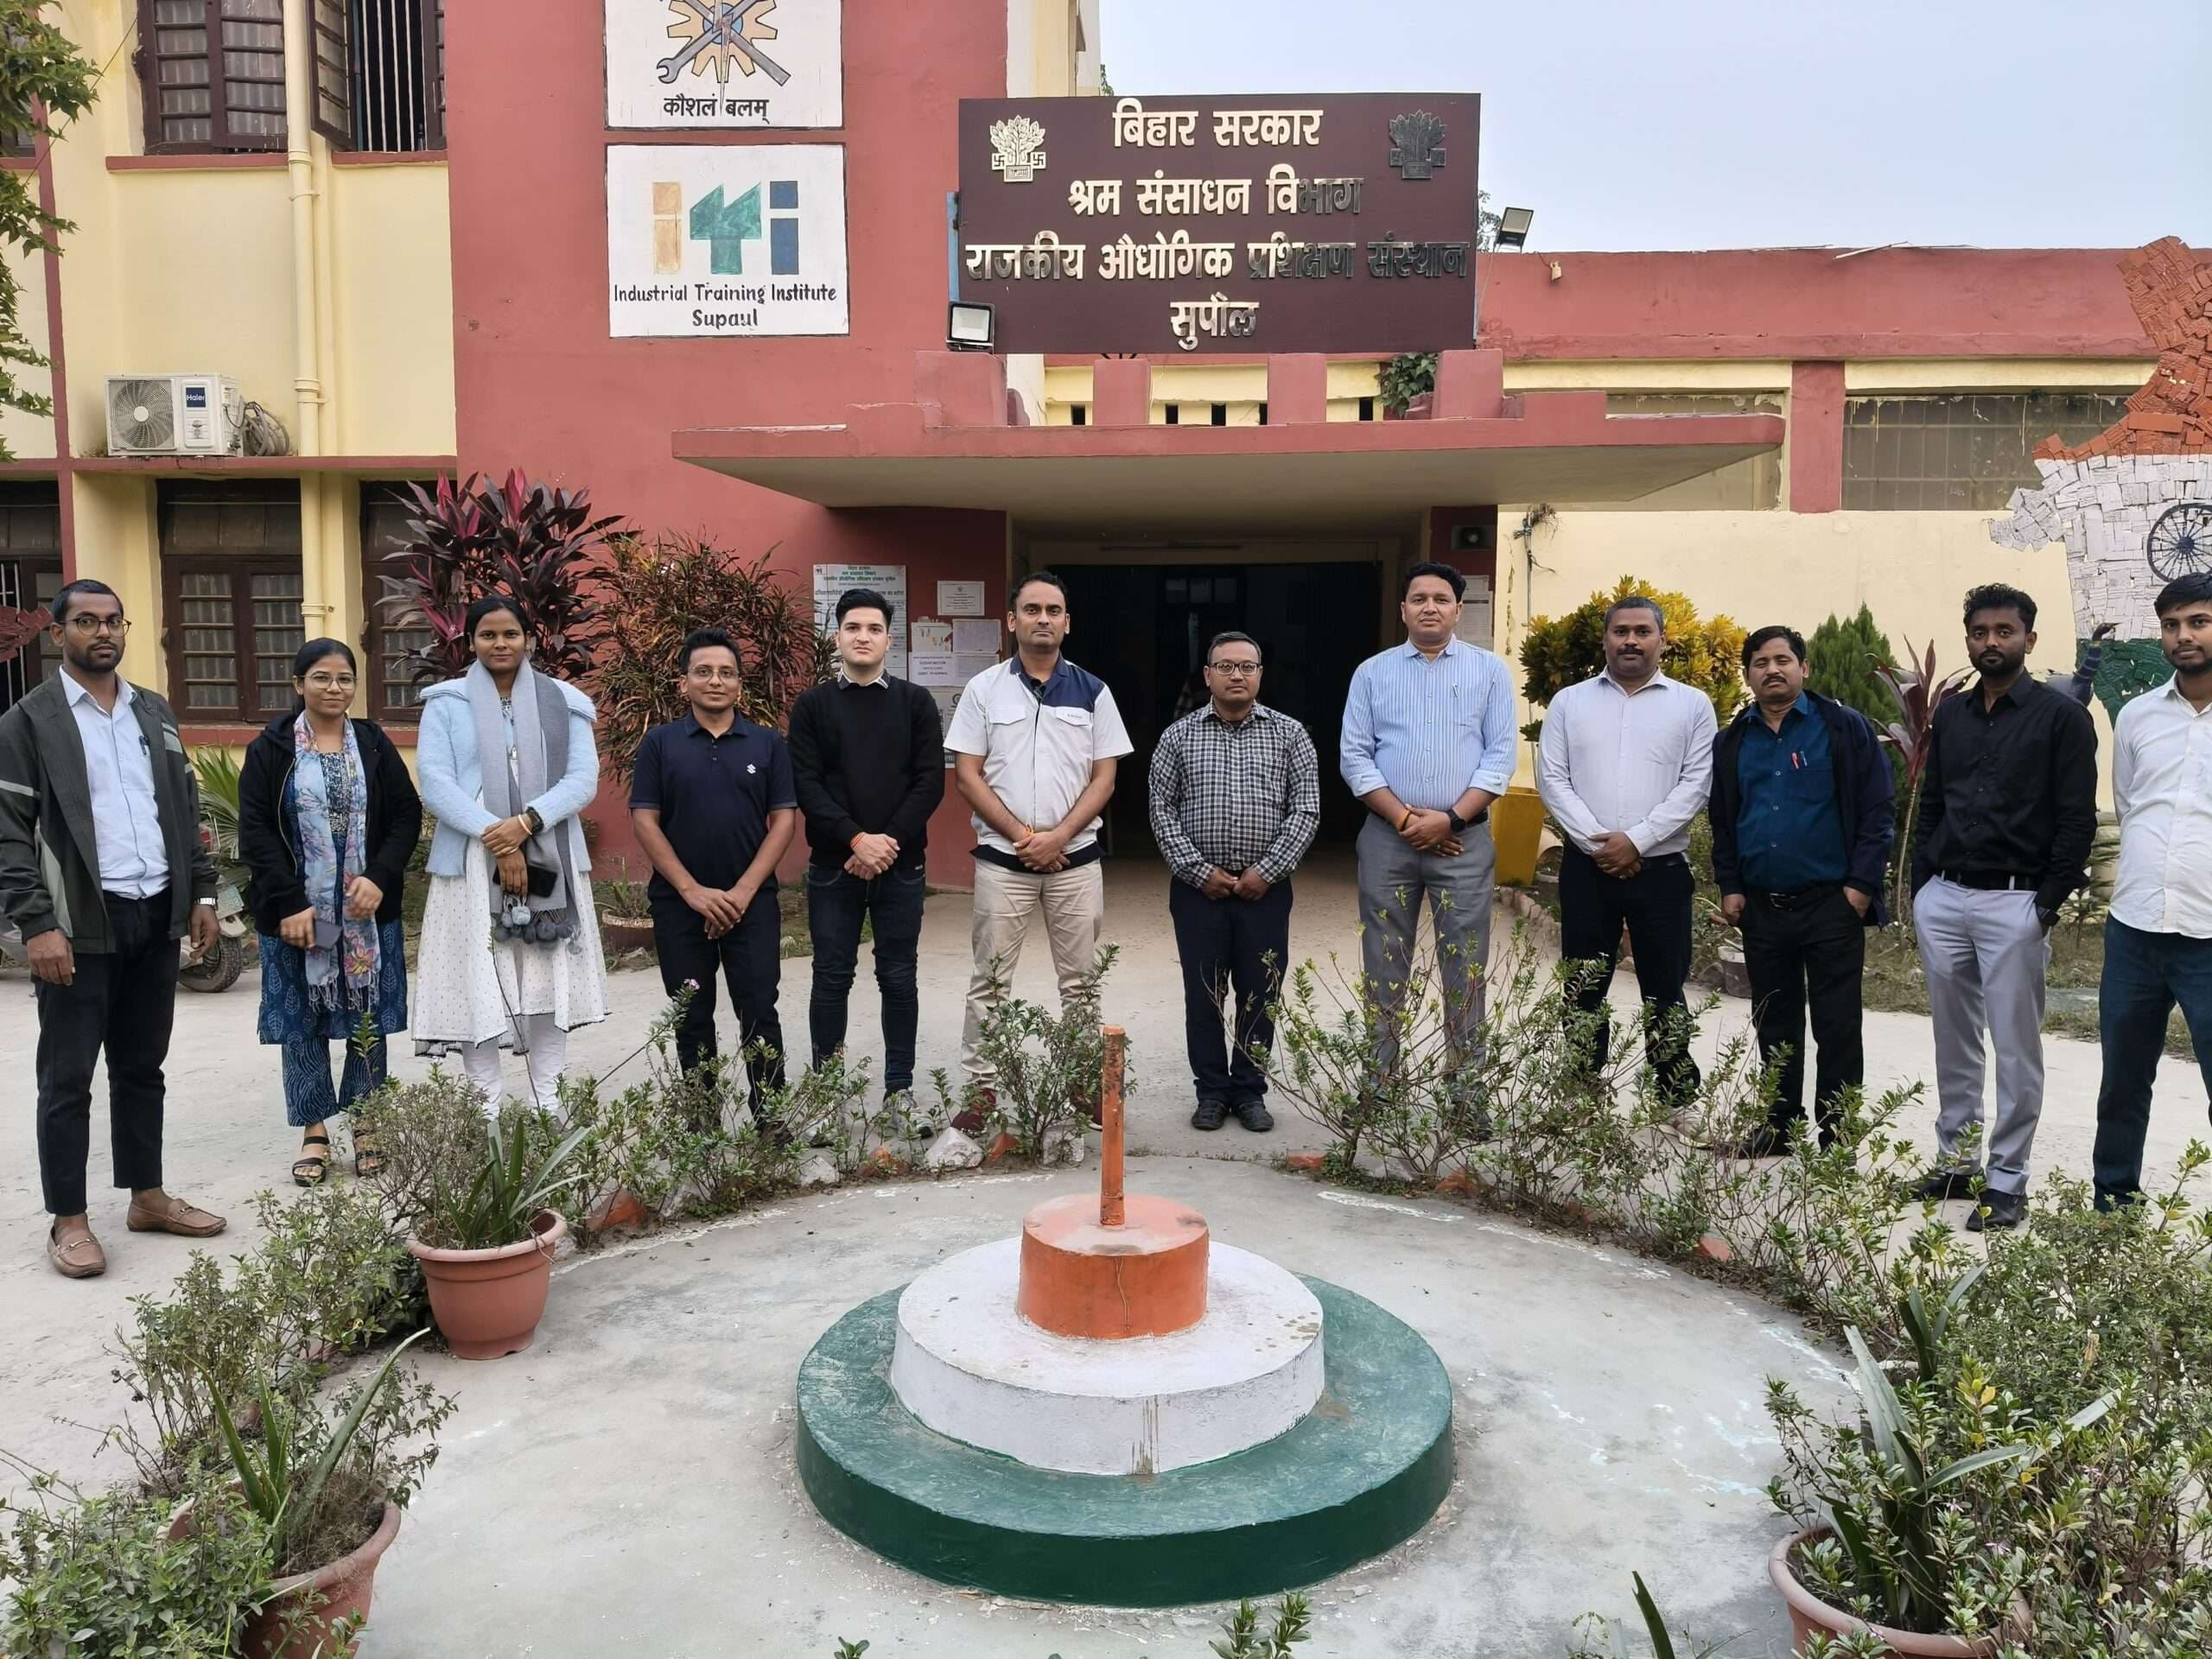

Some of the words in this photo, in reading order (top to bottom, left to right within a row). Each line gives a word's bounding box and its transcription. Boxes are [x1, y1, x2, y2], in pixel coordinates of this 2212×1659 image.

[663, 93, 718, 117] कौशलं
[725, 99, 770, 124] बलम्
[1112, 98, 1198, 147] बिहार
[1213, 110, 1324, 146] सरकार
[1068, 180, 1122, 215] श्रम
[1136, 169, 1252, 215] संसाधन
[1266, 163, 1363, 214] विभाग
[965, 230, 1086, 279] राजकीय
[1247, 231, 1357, 278] प्रशिक्षण
[1367, 230, 1470, 278] संस्थान
[614, 284, 687, 302] Industrial
[694, 283, 765, 304] Training
[772, 283, 837, 301] Institute
[692, 308, 758, 329] Supaul
[1170, 291, 1260, 351] सुपौल
